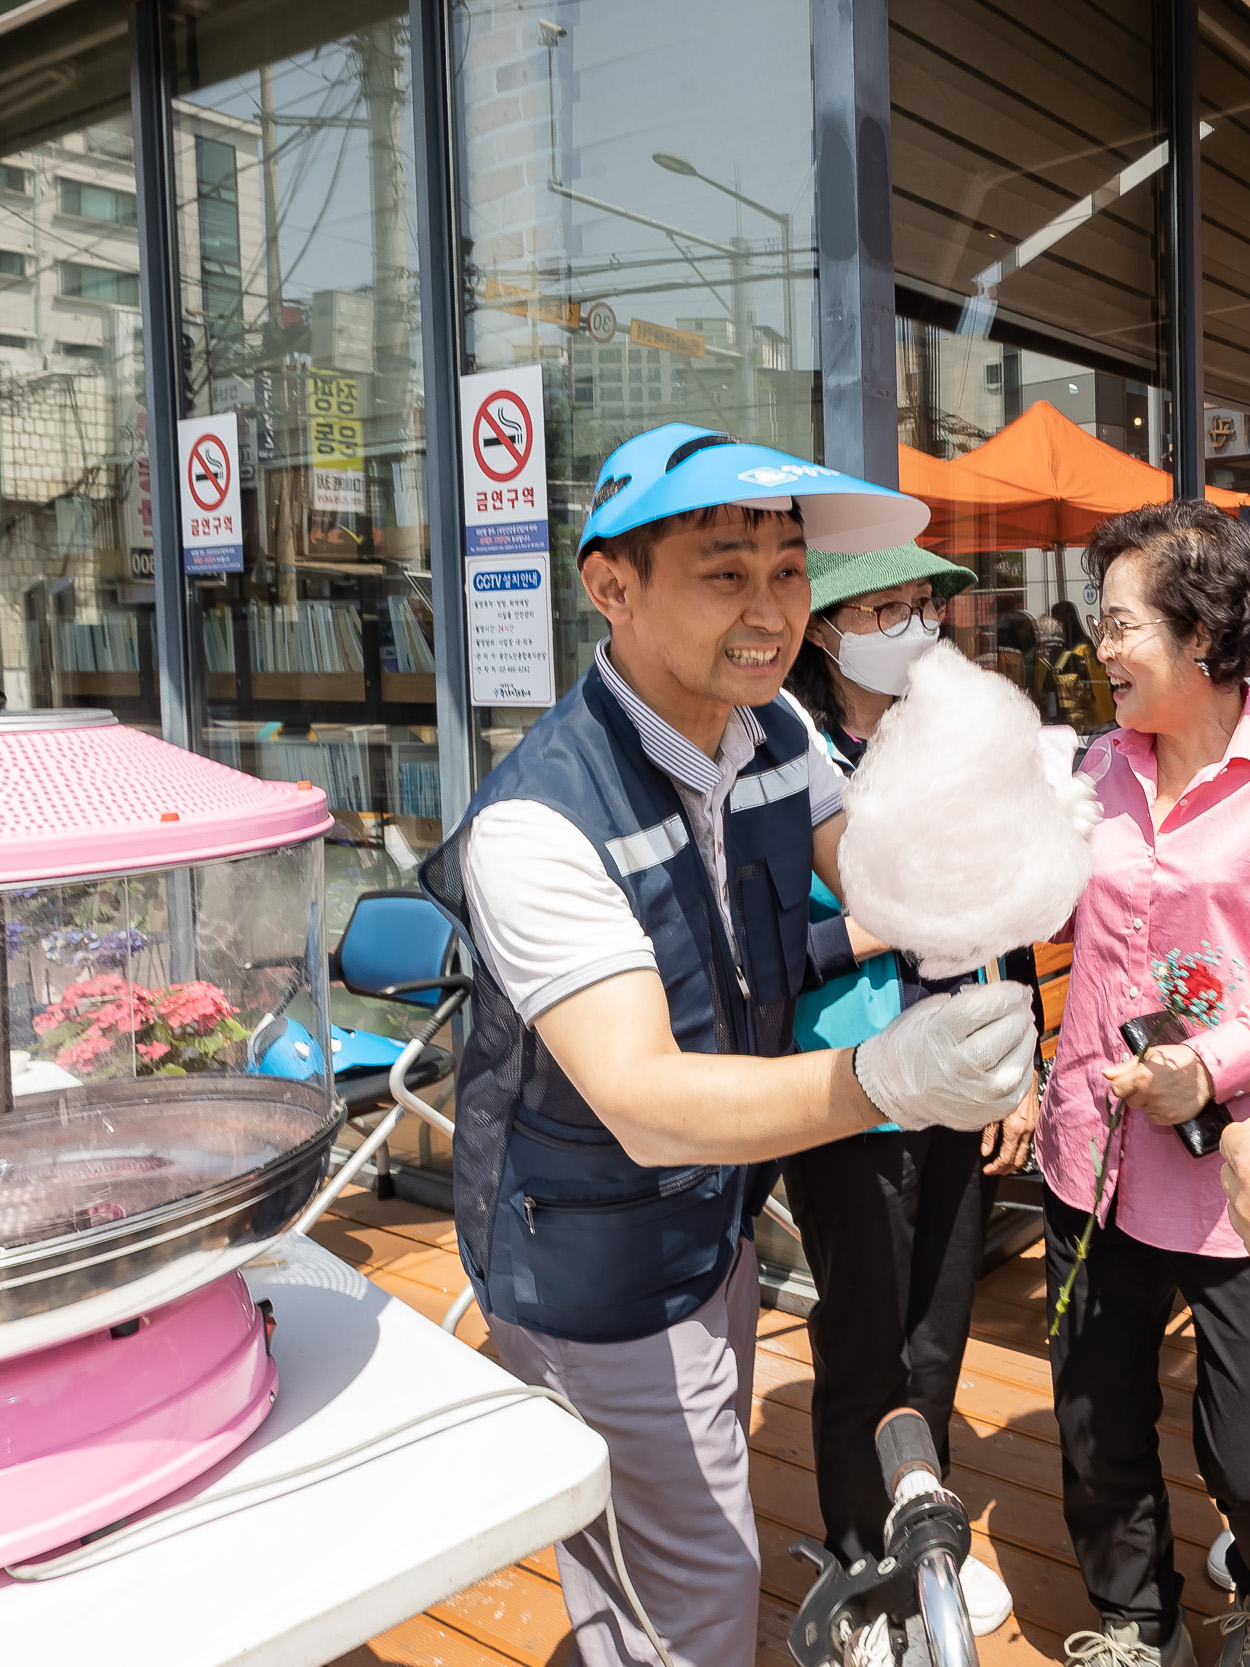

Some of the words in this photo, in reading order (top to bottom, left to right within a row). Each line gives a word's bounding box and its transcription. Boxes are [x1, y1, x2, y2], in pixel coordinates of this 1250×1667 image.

[476, 486, 535, 512] 금연구역
[191, 515, 233, 537] 금연구역
[476, 574, 502, 590] CCTV
